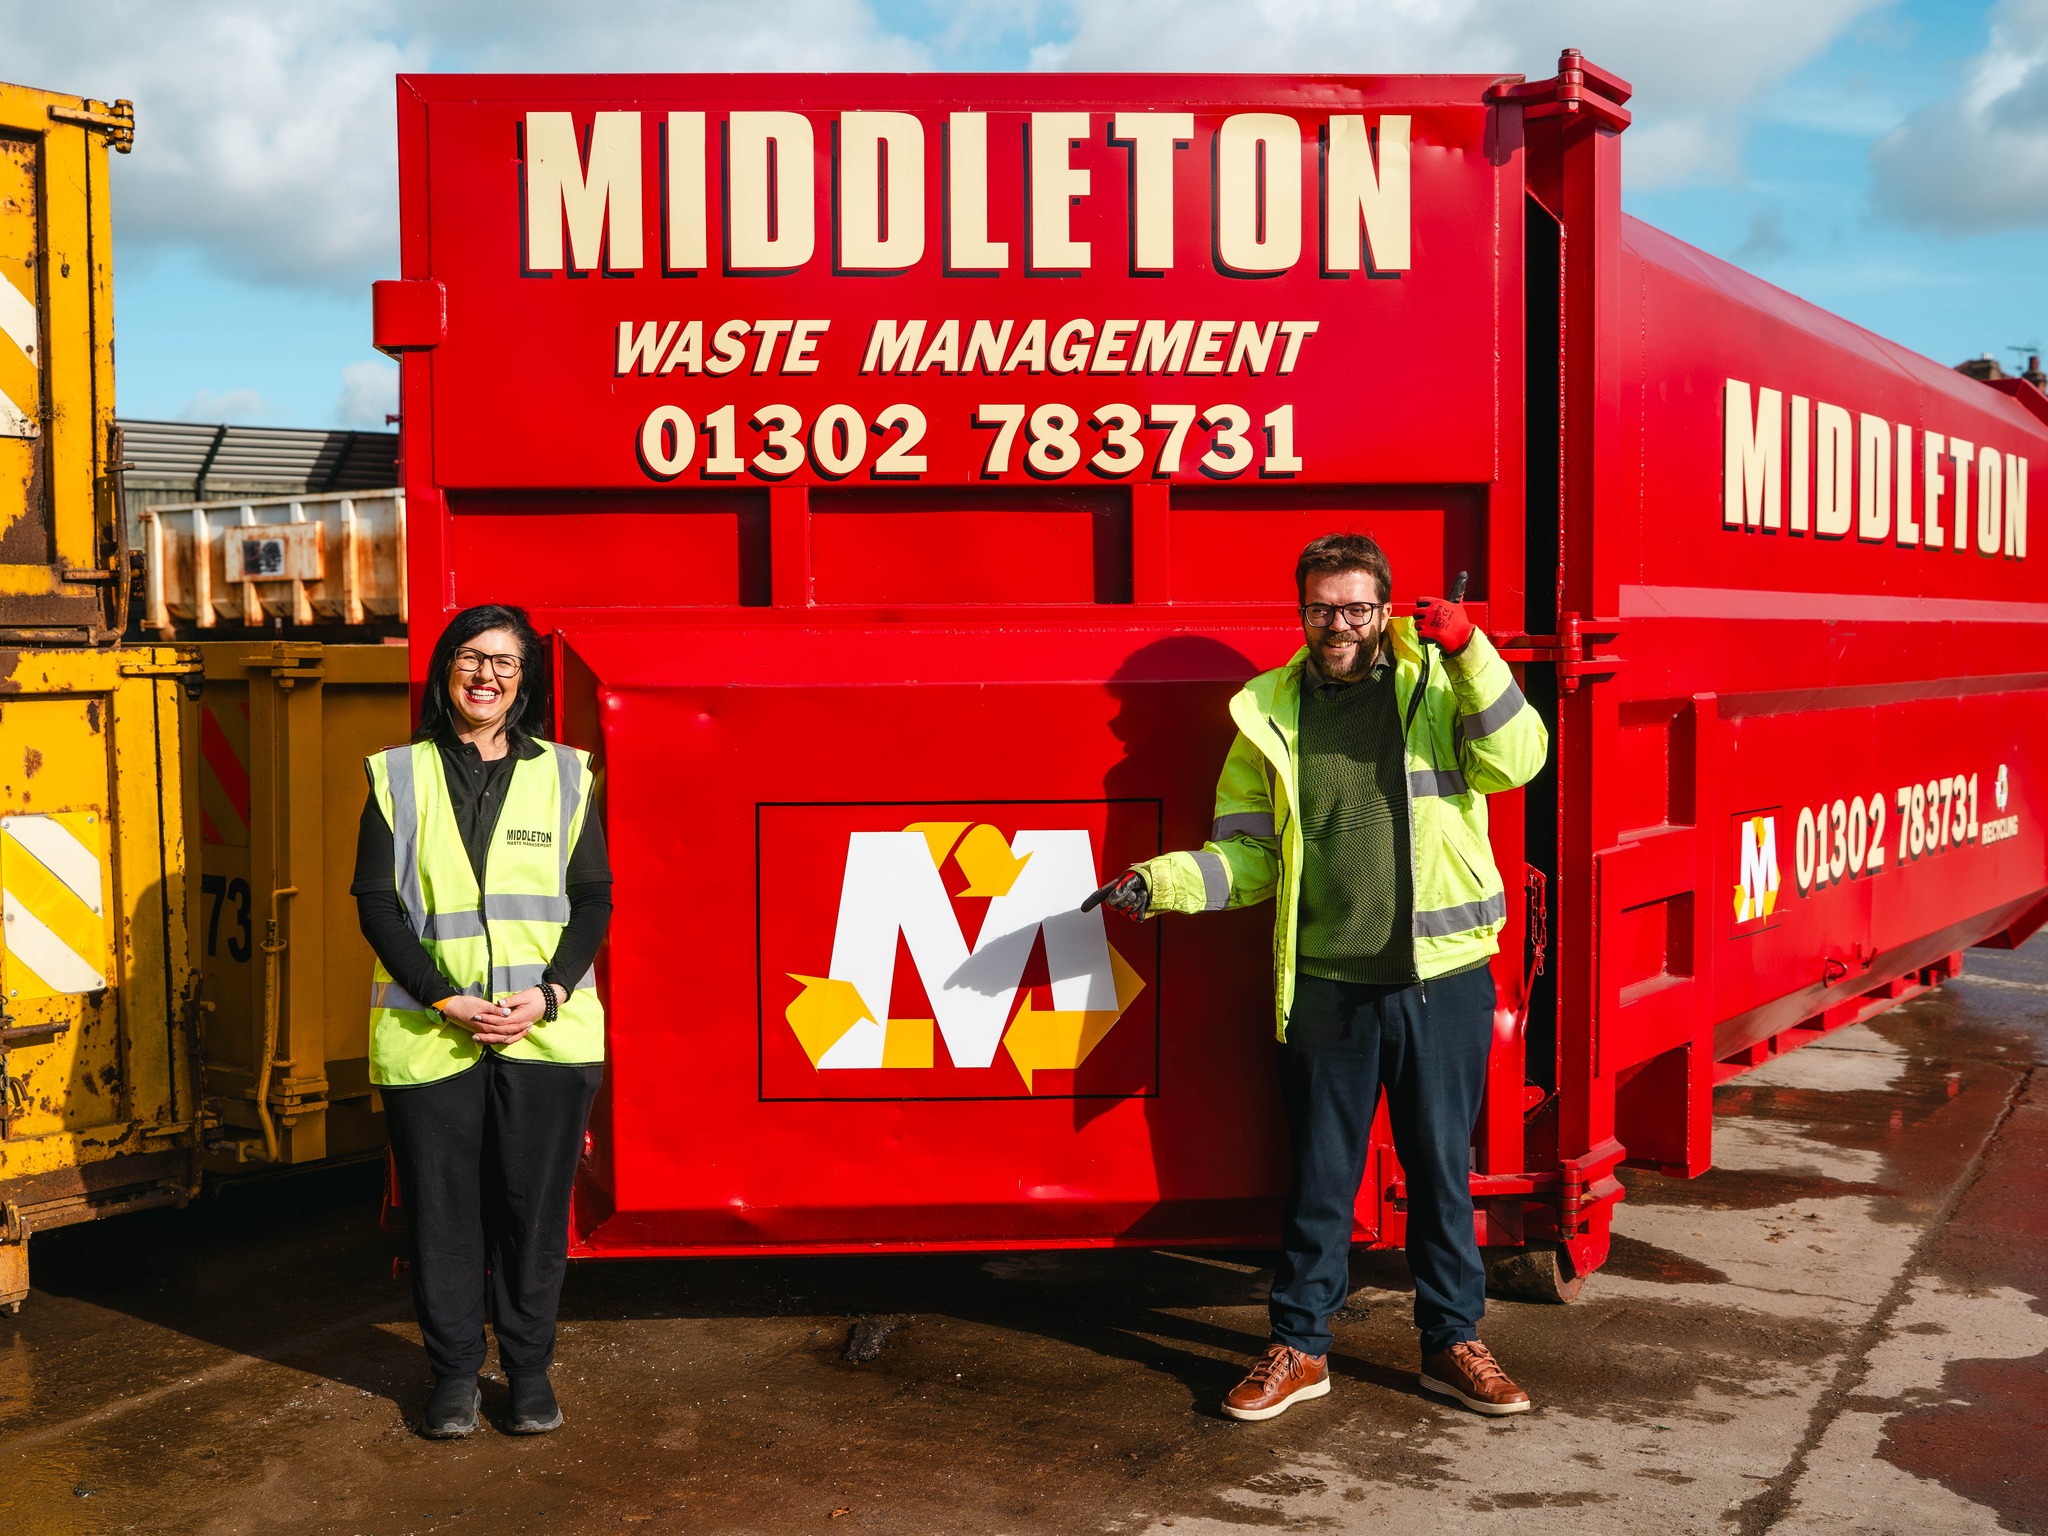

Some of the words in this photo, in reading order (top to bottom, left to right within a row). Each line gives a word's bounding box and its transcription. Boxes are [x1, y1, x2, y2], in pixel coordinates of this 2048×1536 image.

[518, 110, 1412, 278] MIDDLETON
[615, 319, 829, 377] WASTE
[859, 319, 1319, 377] MANAGEMENT
[637, 404, 928, 478] 01302
[972, 404, 1303, 478] 783731
[1723, 377, 2028, 560] MIDDLETON
[506, 829, 552, 844] MIDDLETON
[1795, 792, 1886, 894] 01302
[1896, 772, 1979, 864] 783731
[1981, 814, 2019, 846] RECYCLING
[201, 873, 252, 963] 73
